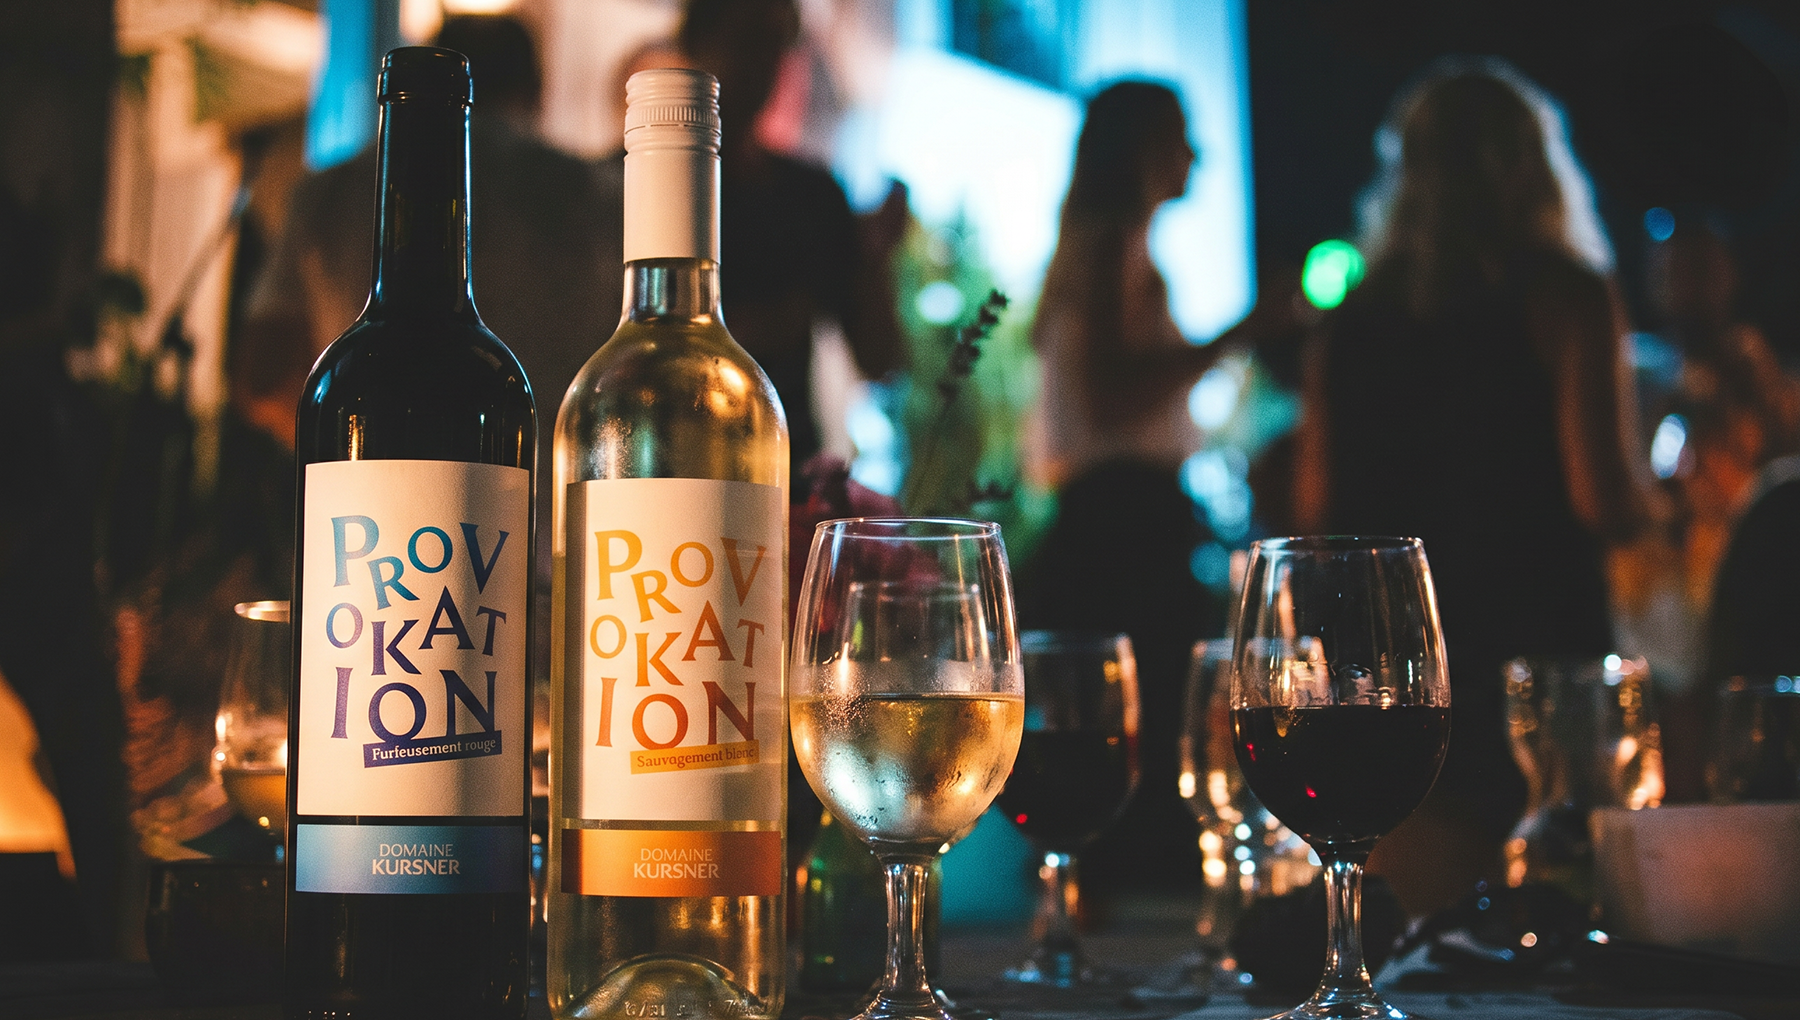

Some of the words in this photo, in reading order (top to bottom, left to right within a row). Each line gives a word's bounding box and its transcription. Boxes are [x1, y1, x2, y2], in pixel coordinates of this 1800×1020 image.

[465, 739, 497, 753] rouge
[636, 750, 723, 769] Sauvagement
[379, 843, 454, 857] DOMAINE
[640, 848, 713, 862] DOMAINE
[372, 858, 460, 875] KURSNER
[633, 863, 720, 879] KURSNER
